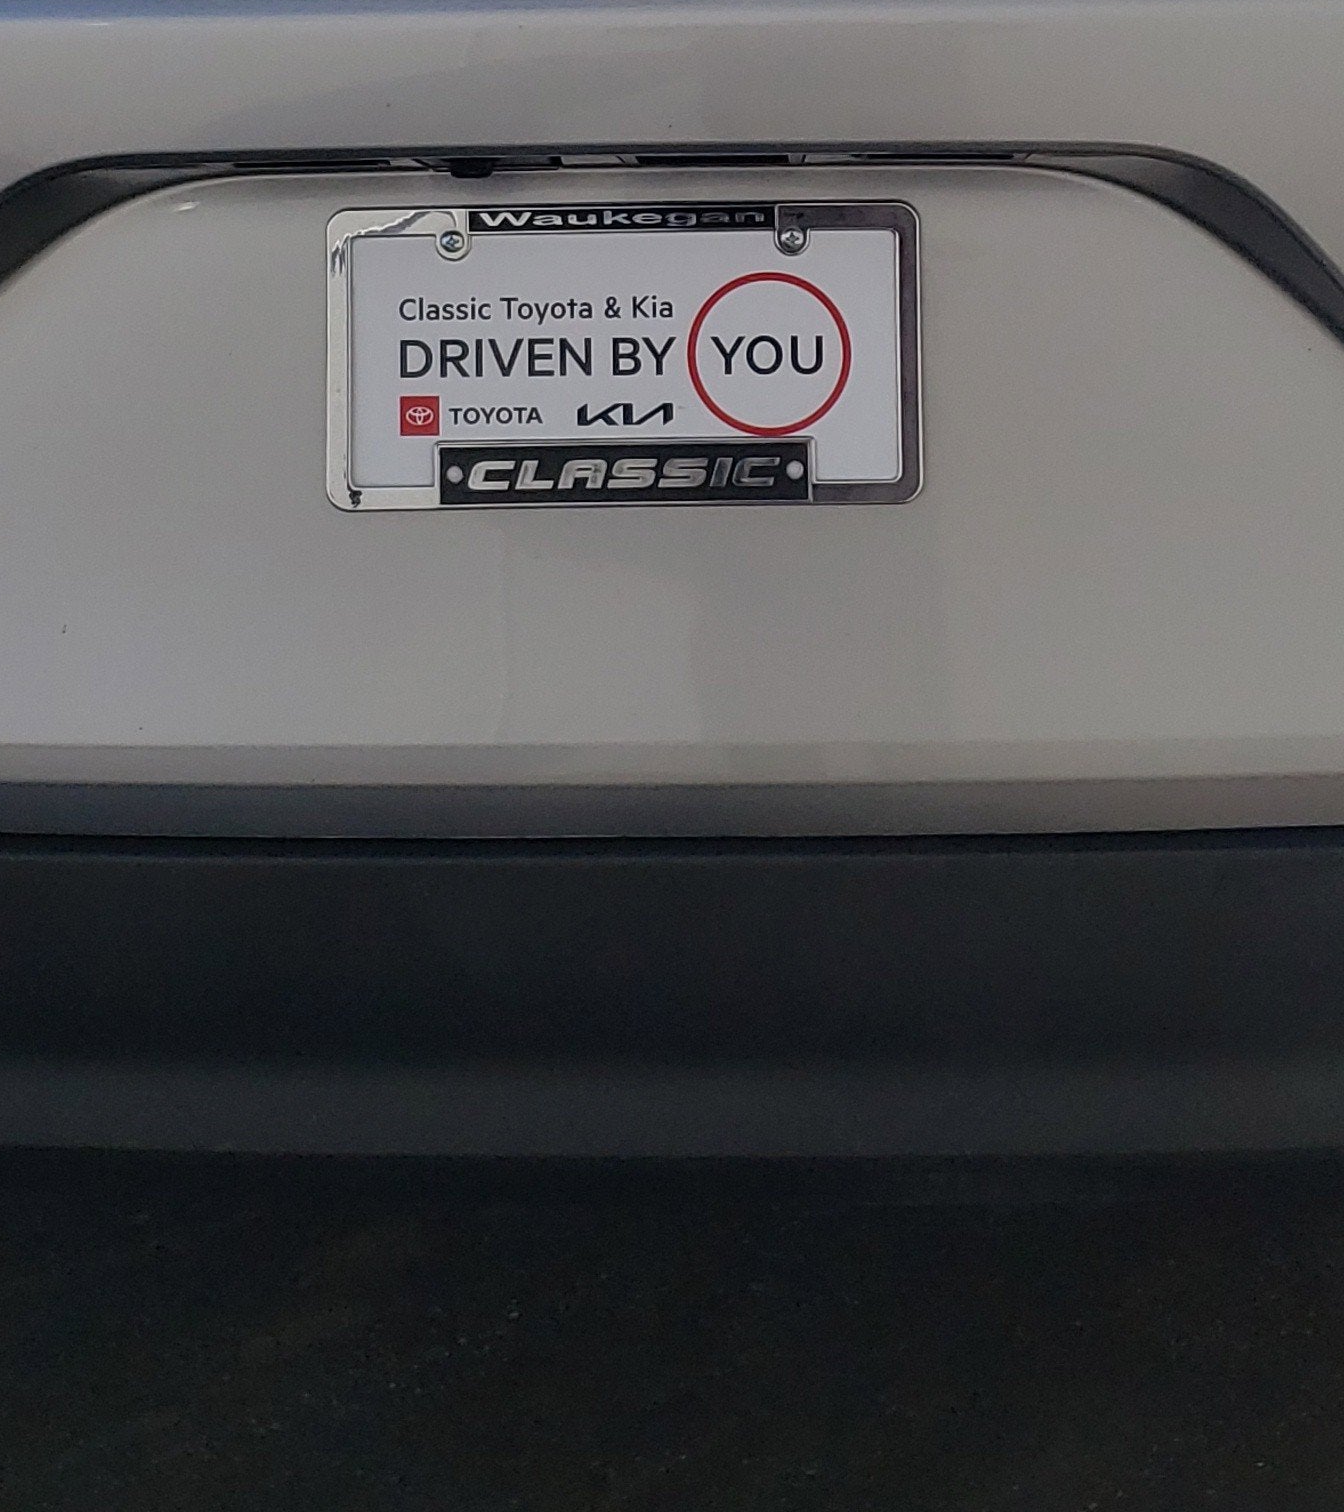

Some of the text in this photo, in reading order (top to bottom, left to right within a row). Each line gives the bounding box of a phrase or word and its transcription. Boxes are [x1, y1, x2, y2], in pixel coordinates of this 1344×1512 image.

[478, 209, 766, 229] Waukegan
[399, 295, 674, 325] Classic Toyota & Kia
[399, 335, 824, 379] DRIVEN BY YOU
[449, 406, 543, 426] TOYOTA
[467, 456, 781, 491] CLASSIC
